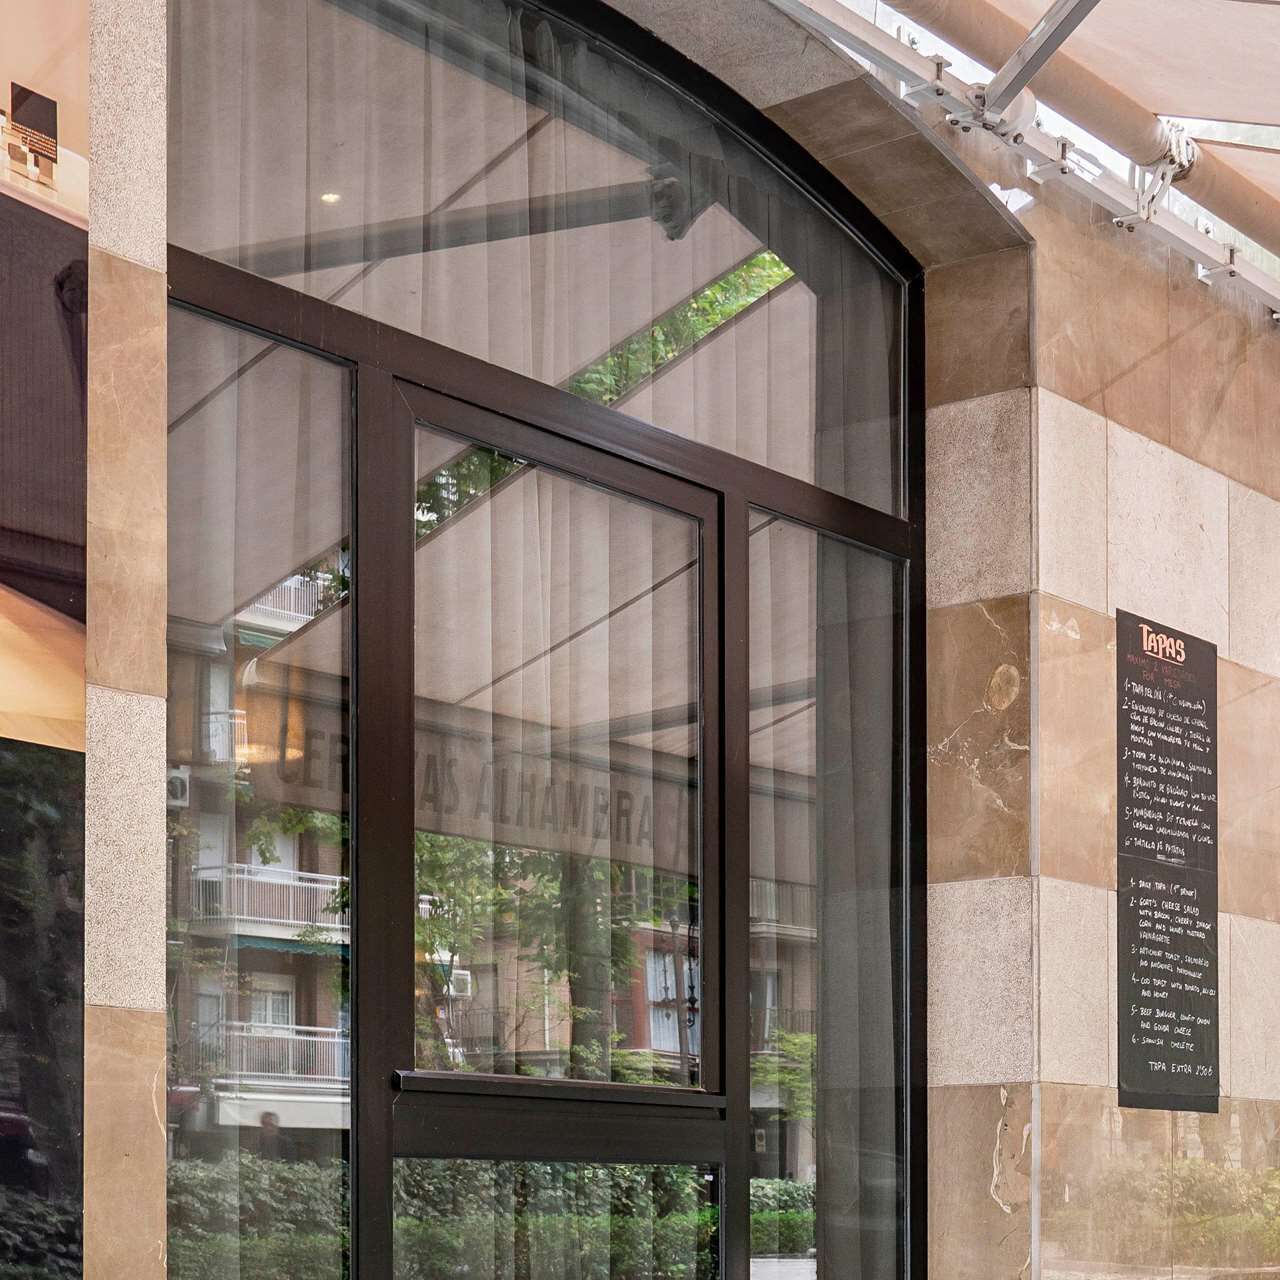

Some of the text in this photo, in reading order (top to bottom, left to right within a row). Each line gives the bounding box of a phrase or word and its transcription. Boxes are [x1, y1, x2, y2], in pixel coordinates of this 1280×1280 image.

[1138, 624, 1186, 662] TAPAS
[1162, 900, 1180, 911] CHEESE
[1183, 904, 1200, 917] SALAD
[1140, 977, 1151, 985] COD
[1140, 1007, 1152, 1016] BEEF
[1140, 1020, 1151, 1029] AND
[1148, 1061, 1166, 1072] TAPA
[1171, 1063, 1192, 1074] EXTRA
